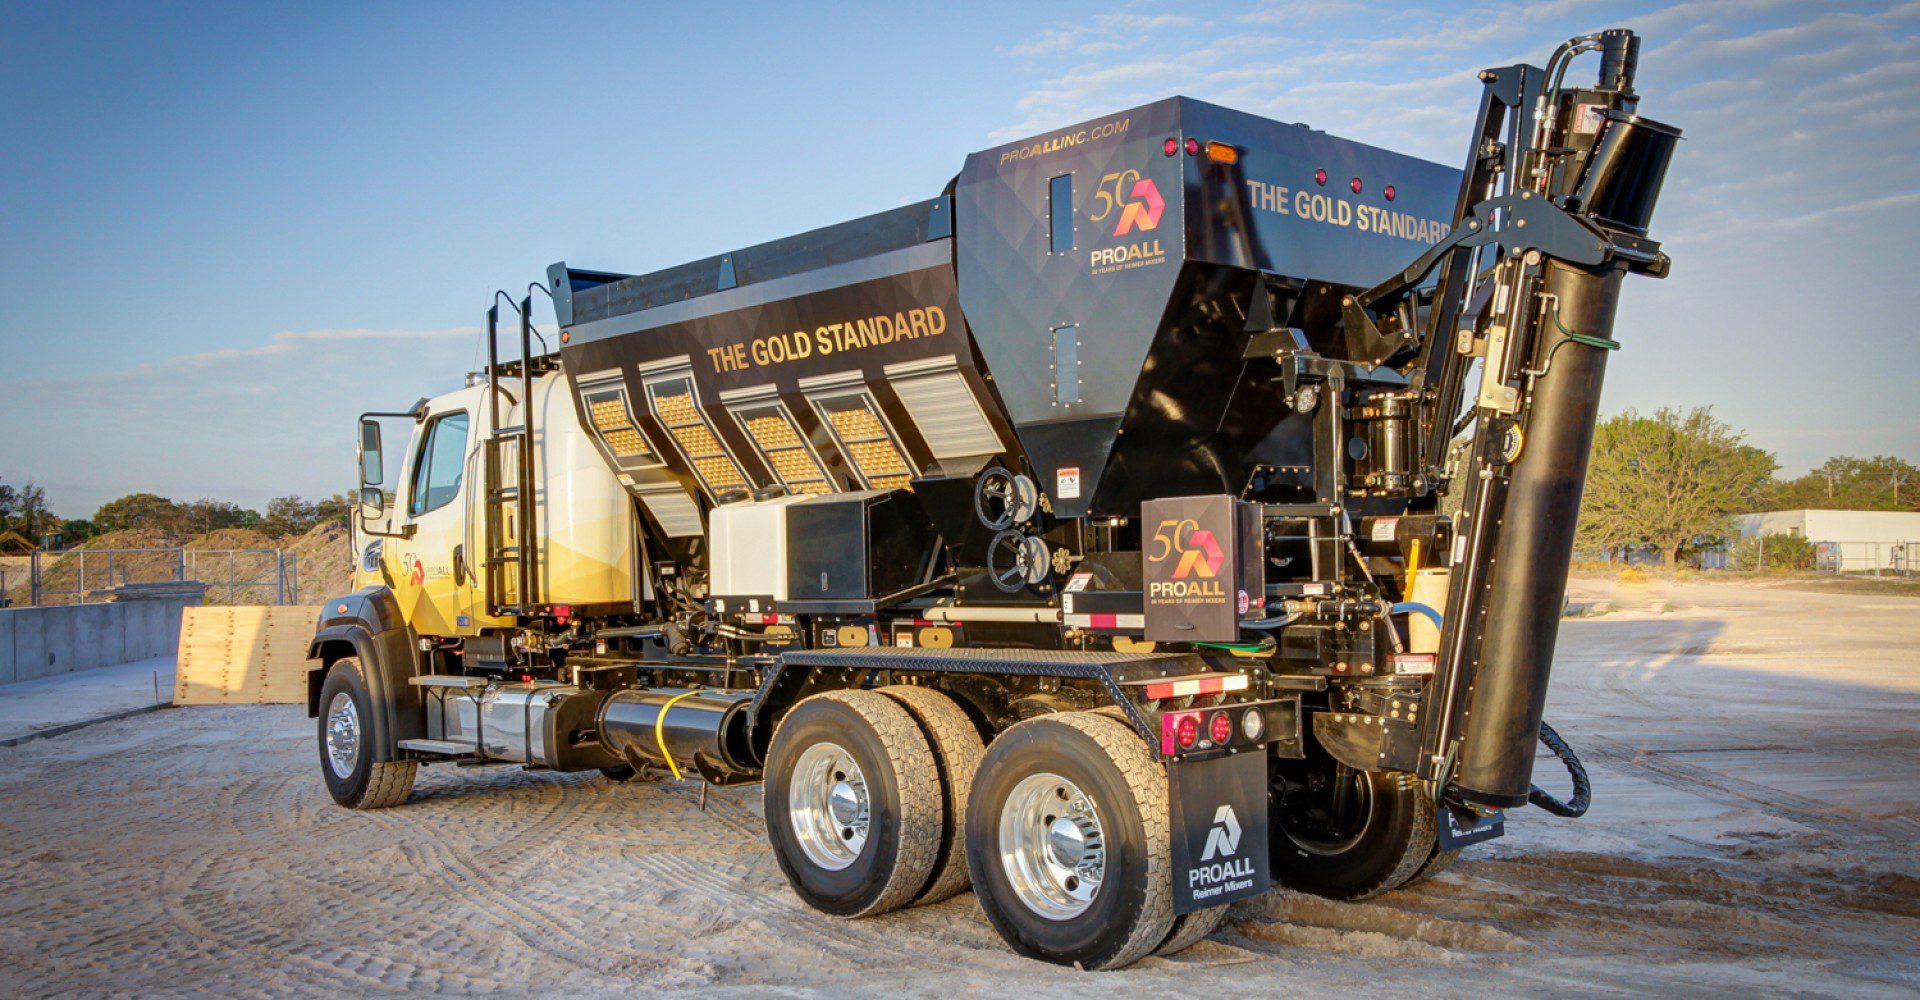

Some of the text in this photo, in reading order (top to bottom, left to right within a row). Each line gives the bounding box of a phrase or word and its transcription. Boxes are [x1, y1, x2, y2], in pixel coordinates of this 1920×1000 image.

[1000, 118, 1130, 165] PROALLINC.COM
[1246, 180, 1451, 245] THE GOLD STANDARD
[1091, 240, 1165, 268] PROALL
[707, 305, 947, 374] THE GOLD STANDARD
[1150, 581, 1225, 598] PROALL
[1188, 857, 1255, 888] PROALL
[1192, 878, 1253, 900] Reimer Mixers
